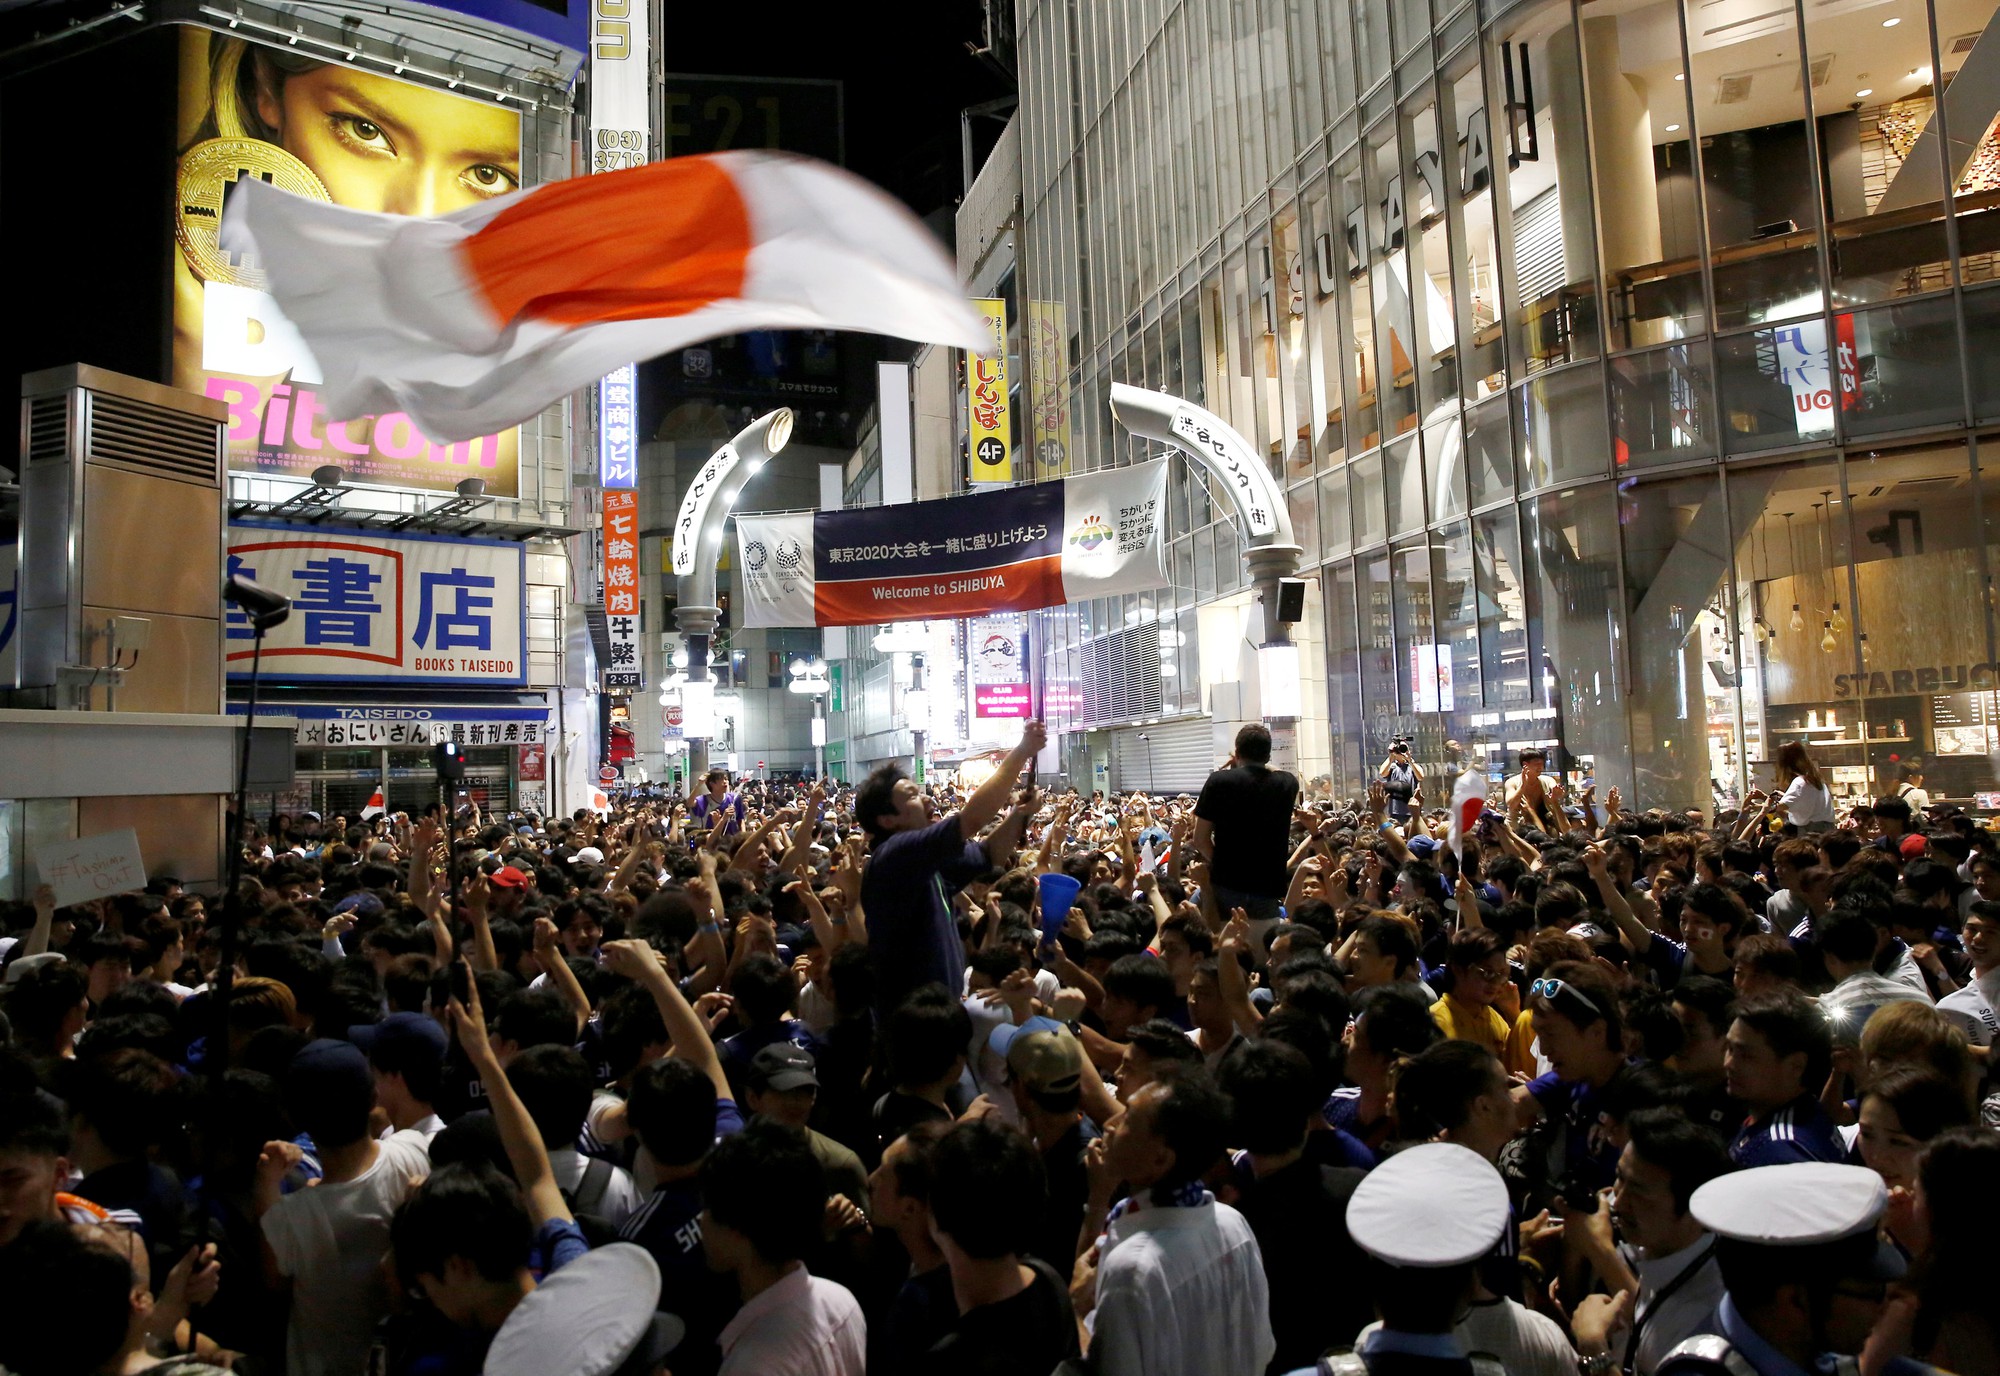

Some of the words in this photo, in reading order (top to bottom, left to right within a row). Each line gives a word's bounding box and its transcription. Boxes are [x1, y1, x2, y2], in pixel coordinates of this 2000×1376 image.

[597, 129, 643, 151] (03)
[594, 150, 646, 169] 3719
[184, 205, 217, 218] DMM
[974, 316, 1006, 431] しんぼ
[779, 382, 838, 394] スマホでサカつく
[978, 441, 1002, 460] 4F
[1180, 415, 1267, 526] 渋谷センター街
[606, 493, 634, 508] 元氣
[677, 451, 729, 571] 渋谷センター街
[1120, 499, 1156, 518] ちがいを
[1119, 513, 1153, 530] ちからに
[1118, 522, 1158, 543] 変える街。
[829, 524, 1048, 563] 東京2020大会を一緒に盛り上げよう
[1117, 537, 1145, 555] 渋谷区
[608, 515, 634, 612] 七輪焼肉
[872, 585, 930, 600] Welcome
[934, 583, 946, 596] to
[949, 574, 1005, 594] SHIBUYA
[611, 617, 635, 665] 牛繁
[415, 658, 455, 672] BOOKS
[460, 659, 513, 673] TAISEIDO
[1834, 662, 2000, 698] STARBUC
[336, 708, 432, 720] TAISEIDO
[674, 1210, 704, 1254] SH
